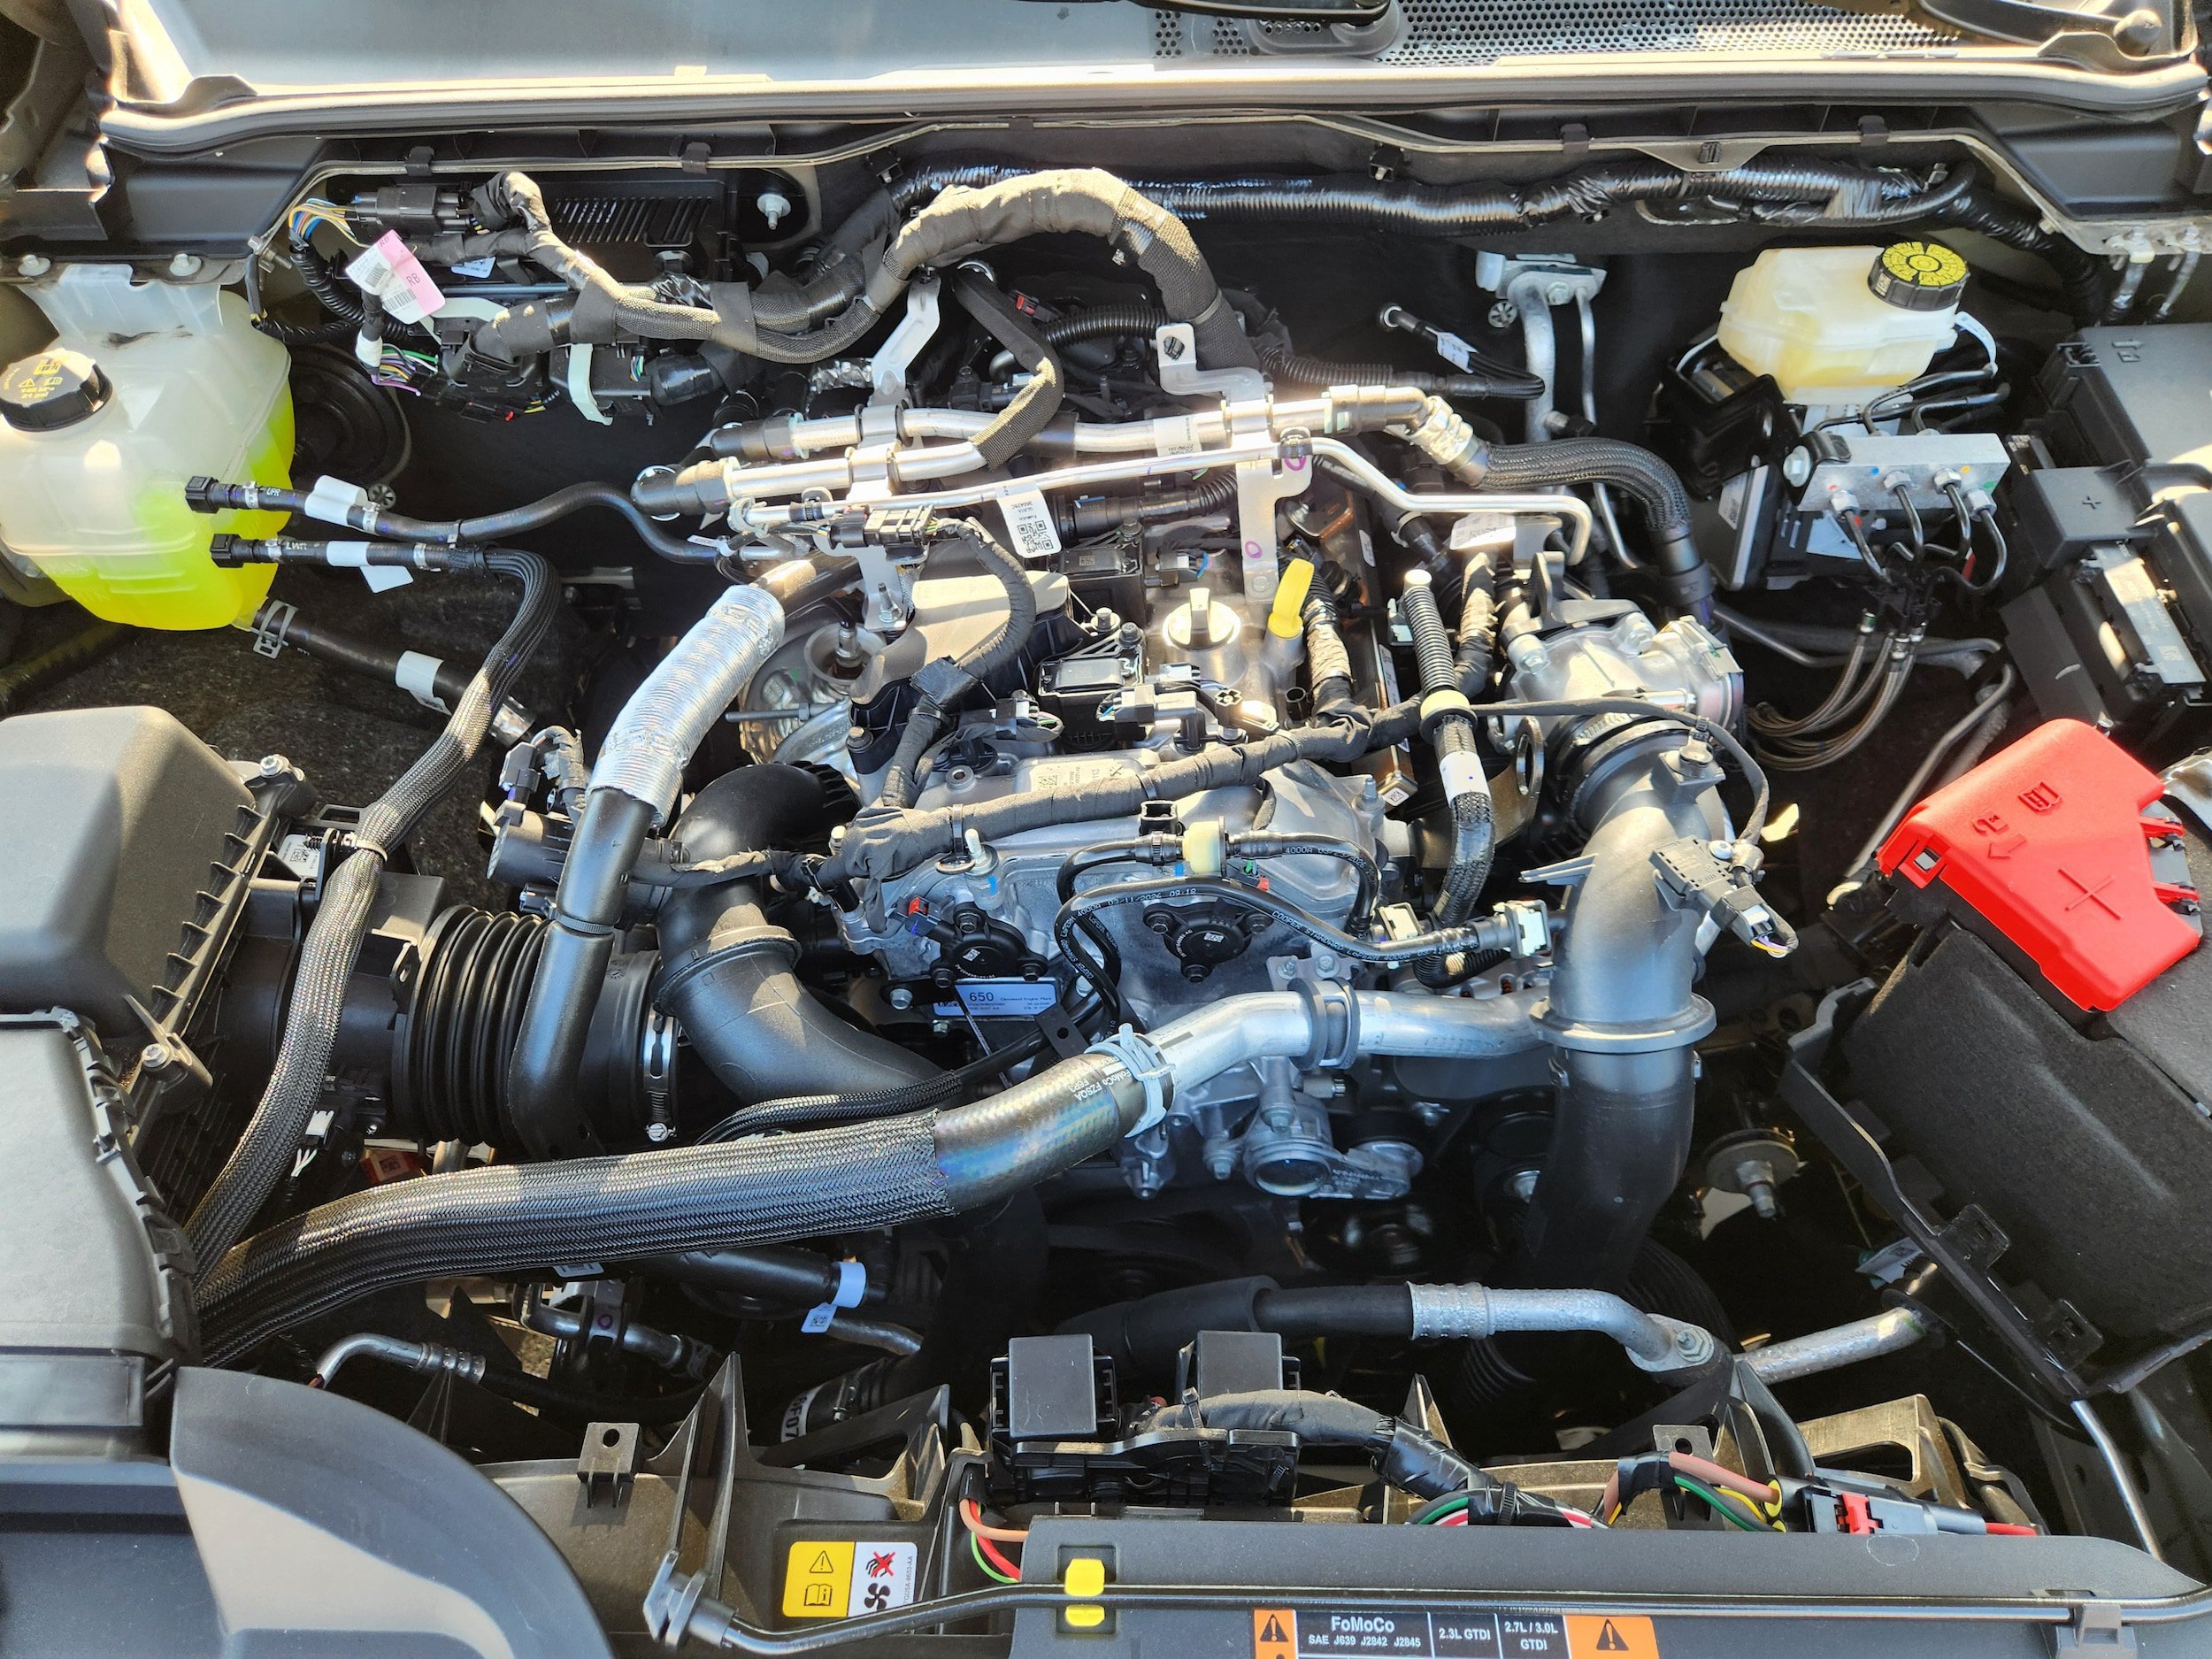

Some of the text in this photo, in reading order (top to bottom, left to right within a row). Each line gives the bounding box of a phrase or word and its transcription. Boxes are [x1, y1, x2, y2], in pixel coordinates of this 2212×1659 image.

[406, 273, 421, 287] RB
[266, 488, 280, 497] UPR
[1271, 910, 1302, 930] COOPER
[1304, 927, 1344, 951] STANDARD
[970, 992, 994, 1002] 650
[1102, 1069, 1132, 1086] FoMoCo
[1068, 1079, 1089, 1093] F6P3
[1074, 1081, 1102, 1101] FZSQA
[1331, 1616, 1395, 1633] FoMoCo
[1504, 1621, 1528, 1633] 2.7L
[1535, 1622, 1559, 1634] 3.0L
[1308, 1634, 1422, 1647] SAE J639 J2842 J2845
[1439, 1628, 1491, 1640] 2.3L GTDI
[1520, 1639, 1548, 1650] GTDI
